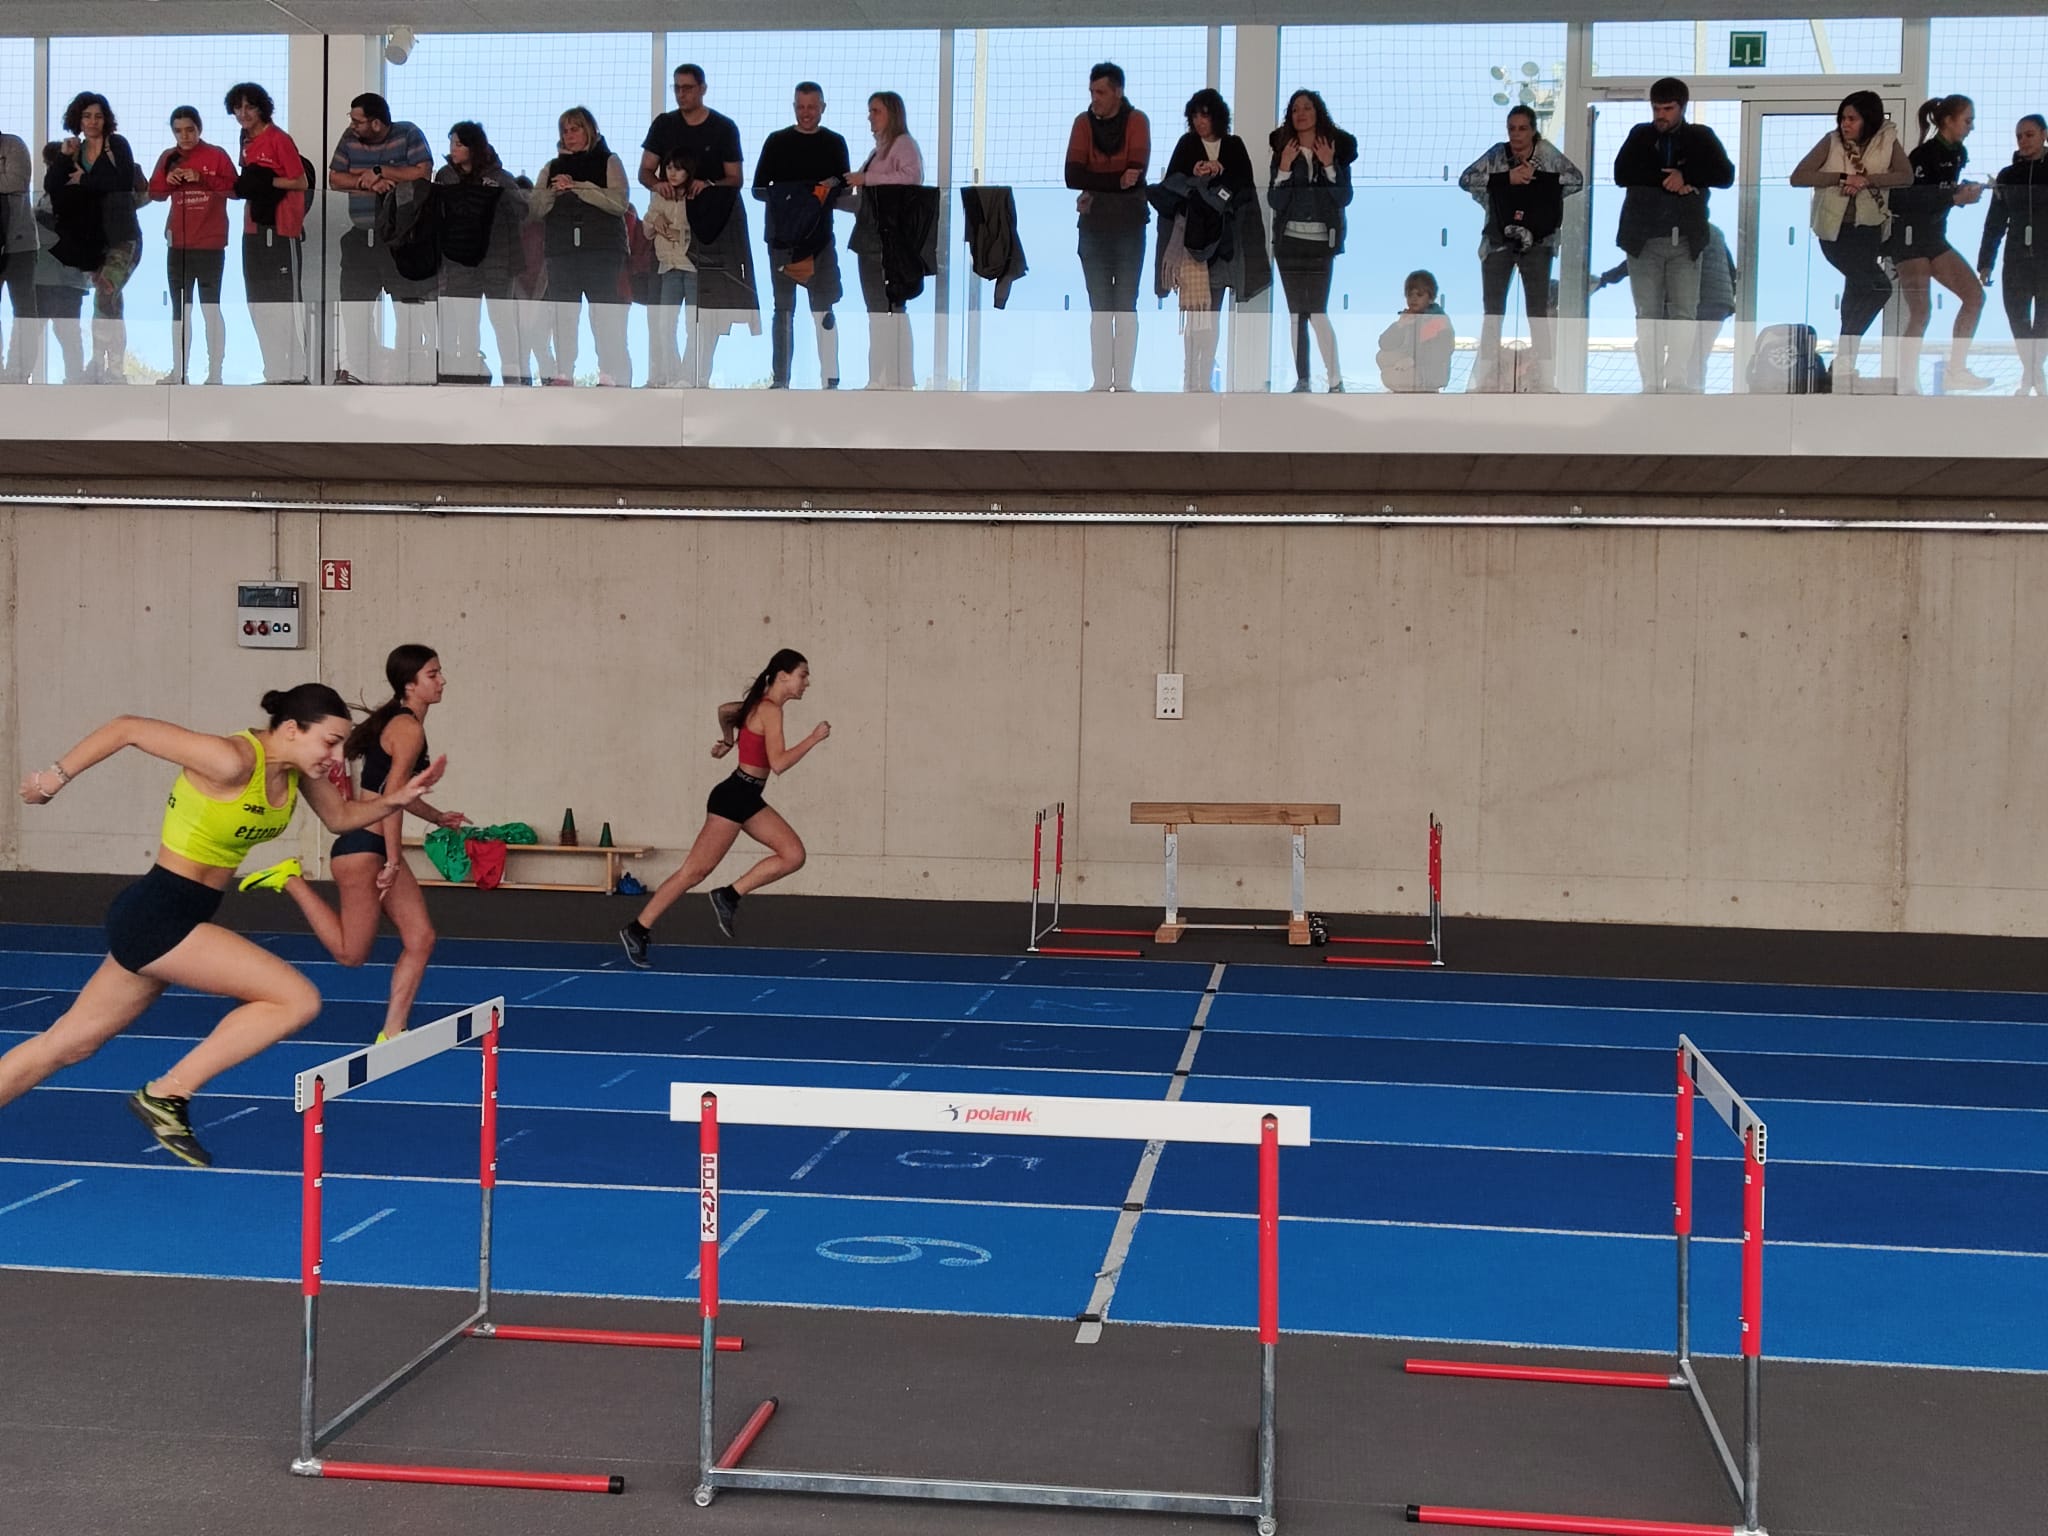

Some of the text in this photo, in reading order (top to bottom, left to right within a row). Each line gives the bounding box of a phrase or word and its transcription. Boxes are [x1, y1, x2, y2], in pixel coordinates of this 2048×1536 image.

[964, 1106, 1033, 1123] polanik
[896, 1149, 1044, 1171] 5
[702, 1156, 716, 1234] POLANIK
[815, 1235, 993, 1267] 6
